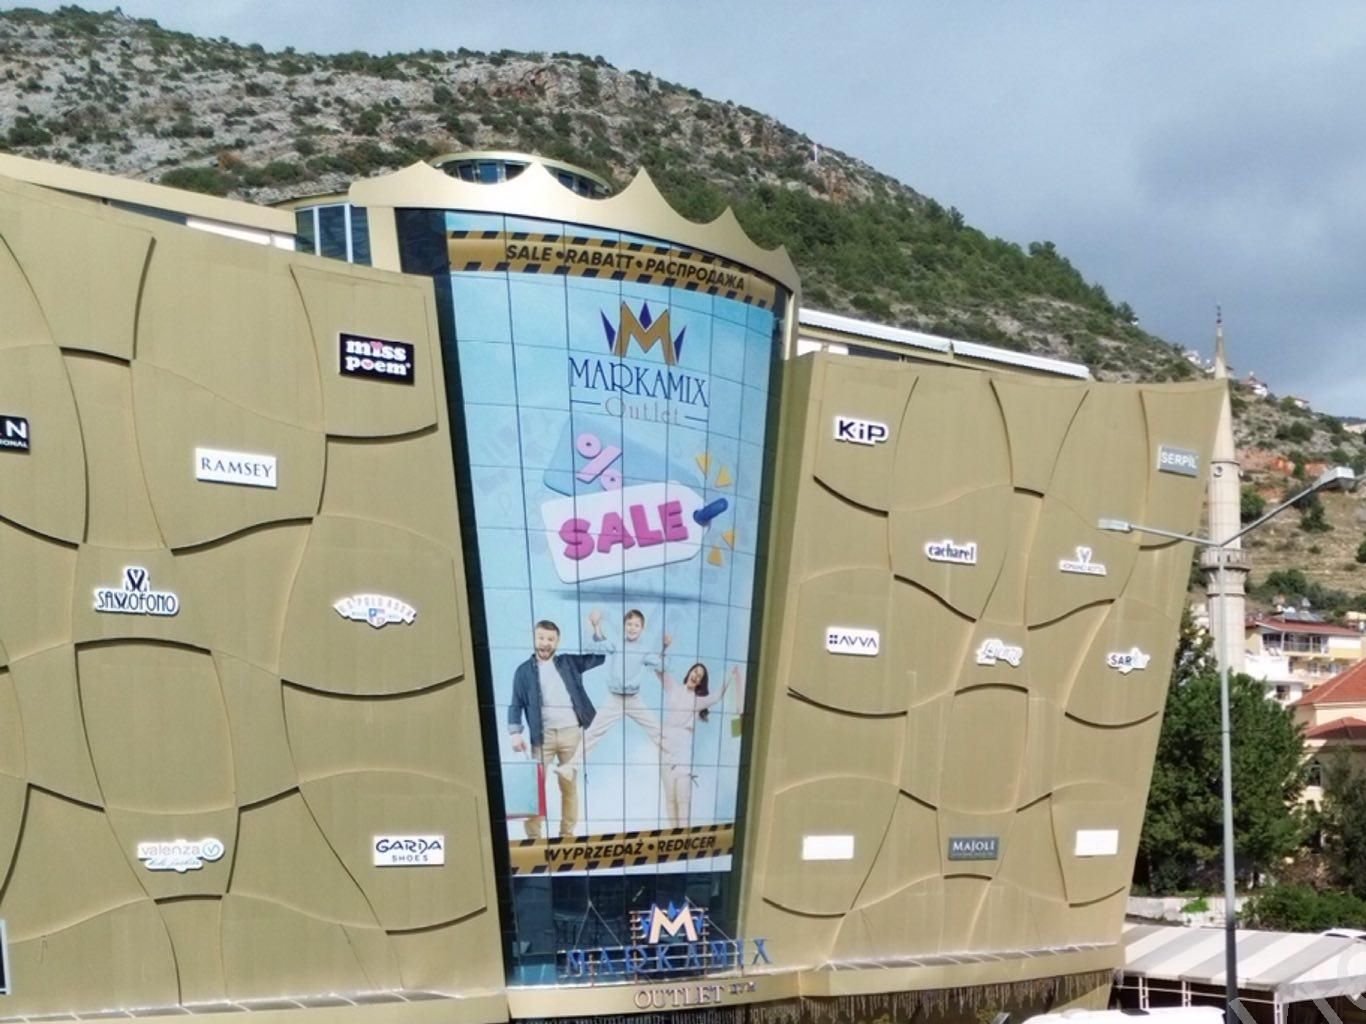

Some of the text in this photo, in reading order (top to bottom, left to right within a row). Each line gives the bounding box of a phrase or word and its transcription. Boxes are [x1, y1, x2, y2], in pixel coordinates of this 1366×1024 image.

[506, 244, 553, 262] SALE
[563, 249, 634, 269] RABATT
[345, 340, 407, 362] miss
[344, 356, 407, 376] poem
[569, 357, 709, 408] MARKAMIX
[605, 396, 680, 425] Outlet
[201, 456, 272, 478] RAMSEY
[558, 500, 689, 561] SALE
[141, 844, 200, 857] valenza
[375, 838, 442, 854] GARDA
[544, 839, 643, 861] WYPRZEDAŻ
[391, 854, 428, 862] SHOES
[566, 938, 774, 977] MARKAMIX
[634, 984, 726, 1010] OUTLET
